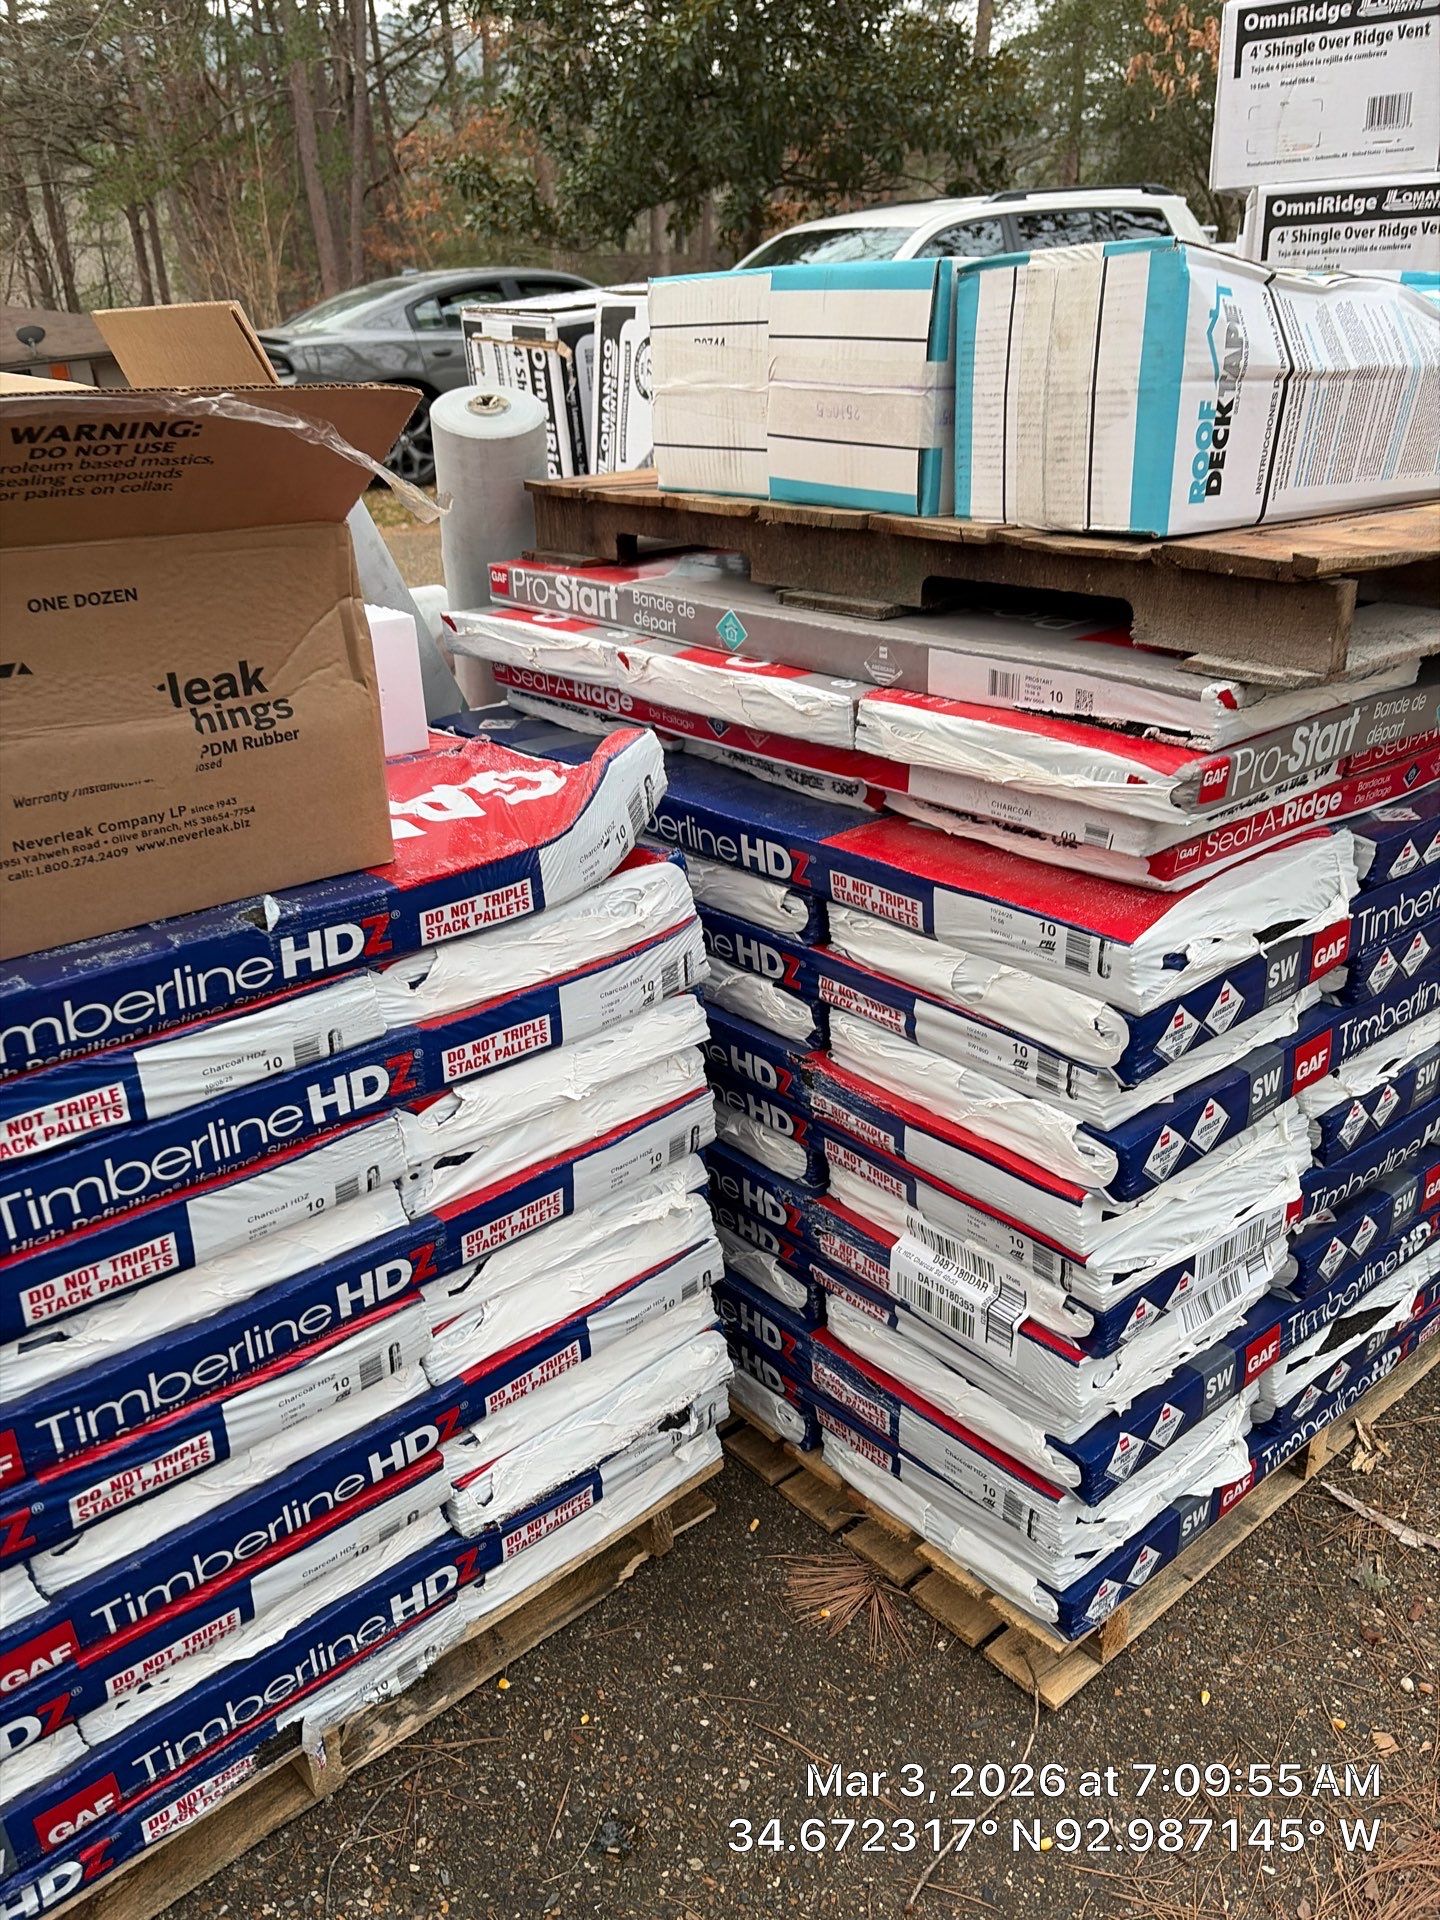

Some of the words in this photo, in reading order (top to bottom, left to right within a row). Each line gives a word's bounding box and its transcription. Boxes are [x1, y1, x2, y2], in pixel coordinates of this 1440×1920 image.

[1244, 1, 1353, 31] OmniRidge
[1250, 43, 1262, 61] 4'
[1264, 38, 1316, 59] Shingle
[1318, 35, 1351, 50] Over
[1353, 27, 1394, 47] Ridge
[1397, 21, 1432, 40] Vent
[1272, 194, 1377, 217] OmniRidge
[1277, 230, 1289, 244] 4'
[1292, 226, 1341, 245] Shingle
[1344, 226, 1376, 240] Over
[1378, 222, 1417, 240] Ridge
[1217, 302, 1244, 397] TAPE
[598, 338, 613, 472] LOMANCO
[10, 420, 203, 445] WARNING:
[28, 446, 66, 460] DO
[74, 443, 129, 458] NOT
[133, 441, 177, 455] USE
[1205, 398, 1235, 496] DECK
[1255, 387, 1279, 495] INSTRUCCIONES
[79, 457, 136, 471] based
[140, 453, 215, 468] mastics,
[1188, 401, 1217, 504] ROOF
[0, 490, 19, 502] or
[24, 486, 85, 502] paints
[91, 484, 115, 496] on
[120, 480, 174, 494] collar.
[72, 467, 184, 486] compounds
[490, 571, 508, 585] GAF
[512, 568, 619, 620] Pro-Start
[27, 594, 70, 613] ONE
[74, 587, 139, 608] DOZEN
[633, 590, 674, 615] Bande
[677, 597, 696, 619] de
[633, 610, 677, 635] départ
[1049, 691, 1063, 704] 10
[1373, 694, 1410, 720] Bande
[1411, 692, 1427, 711] de
[242, 728, 300, 751] Rubber
[1366, 719, 1406, 746] départ
[1231, 707, 1361, 797] Pro-Start
[1203, 765, 1229, 787] GAF
[13, 788, 69, 809] Warranty
[12, 826, 94, 853] Neverleak
[98, 806, 166, 836] Company
[169, 805, 187, 820] LP
[190, 801, 215, 814] since
[216, 797, 238, 810] 1943
[23, 847, 70, 867] Yahweh
[72, 839, 101, 853] Road
[111, 832, 139, 845] Olive
[140, 822, 182, 840] Branch,
[184, 819, 199, 829] MS
[200, 805, 256, 826] 38654-7754
[1205, 790, 1343, 858] Seal-A-Ridge
[7, 868, 34, 882] call:
[35, 846, 129, 877] 1.800.274.2409
[135, 818, 251, 854] www.neverleak.biz
[1179, 845, 1201, 861] GAF
[425, 909, 445, 927] DO
[450, 898, 477, 920] NOT
[483, 882, 530, 910] TRIPLE
[832, 872, 848, 890] DO
[852, 878, 873, 899] NOT
[877, 889, 919, 916] TRIPLE
[834, 886, 868, 912] STACK
[871, 900, 920, 930] PALLETS
[426, 916, 471, 940] STACK
[474, 897, 531, 928] PALLETS
[1039, 921, 1057, 938] 10
[1267, 951, 1300, 990] SW
[1313, 936, 1347, 970] GAF
[640, 979, 655, 996] 10
[201, 1054, 246, 1078] Charcoal
[246, 1047, 268, 1064] HDZ
[262, 1055, 284, 1072] 10
[1012, 1042, 1028, 1058] 10
[1297, 1051, 1329, 1082] GAF
[1252, 1066, 1283, 1102] SW
[6, 1111, 46, 1136] NOT
[54, 1086, 123, 1122] TRIPLE
[43, 1103, 125, 1143] PALLETS
[0, 1104, 304, 1240] Timberline
[247, 1202, 290, 1225] Charcoal
[290, 1191, 310, 1208] HDZ
[305, 1197, 325, 1214] 10
[27, 1283, 55, 1305] DO
[63, 1265, 101, 1291] NOT
[110, 1237, 172, 1272] TRIPLE
[31, 1290, 94, 1321] STACK
[98, 1253, 174, 1292] PALLETS
[918, 1272, 975, 1313] DA110180353
[1248, 1340, 1280, 1373] GAF
[35, 1303, 332, 1454] Timberline
[278, 1382, 315, 1408] Charcoal
[316, 1371, 337, 1389] HDZ
[331, 1377, 350, 1392] 10
[1205, 1364, 1235, 1401] SW
[75, 1488, 102, 1508] DO
[109, 1467, 144, 1490] NOT
[152, 1435, 209, 1471] TRIPLE
[78, 1487, 136, 1521] STACK
[140, 1450, 211, 1491] PALLETS
[1223, 1477, 1251, 1508] GAF
[1181, 1500, 1211, 1538] SW
[90, 1474, 365, 1635] Timberline
[0, 1642, 73, 1693] GAF
[131, 1615, 388, 1782] Timberline
[48, 1790, 115, 1846] GAF
